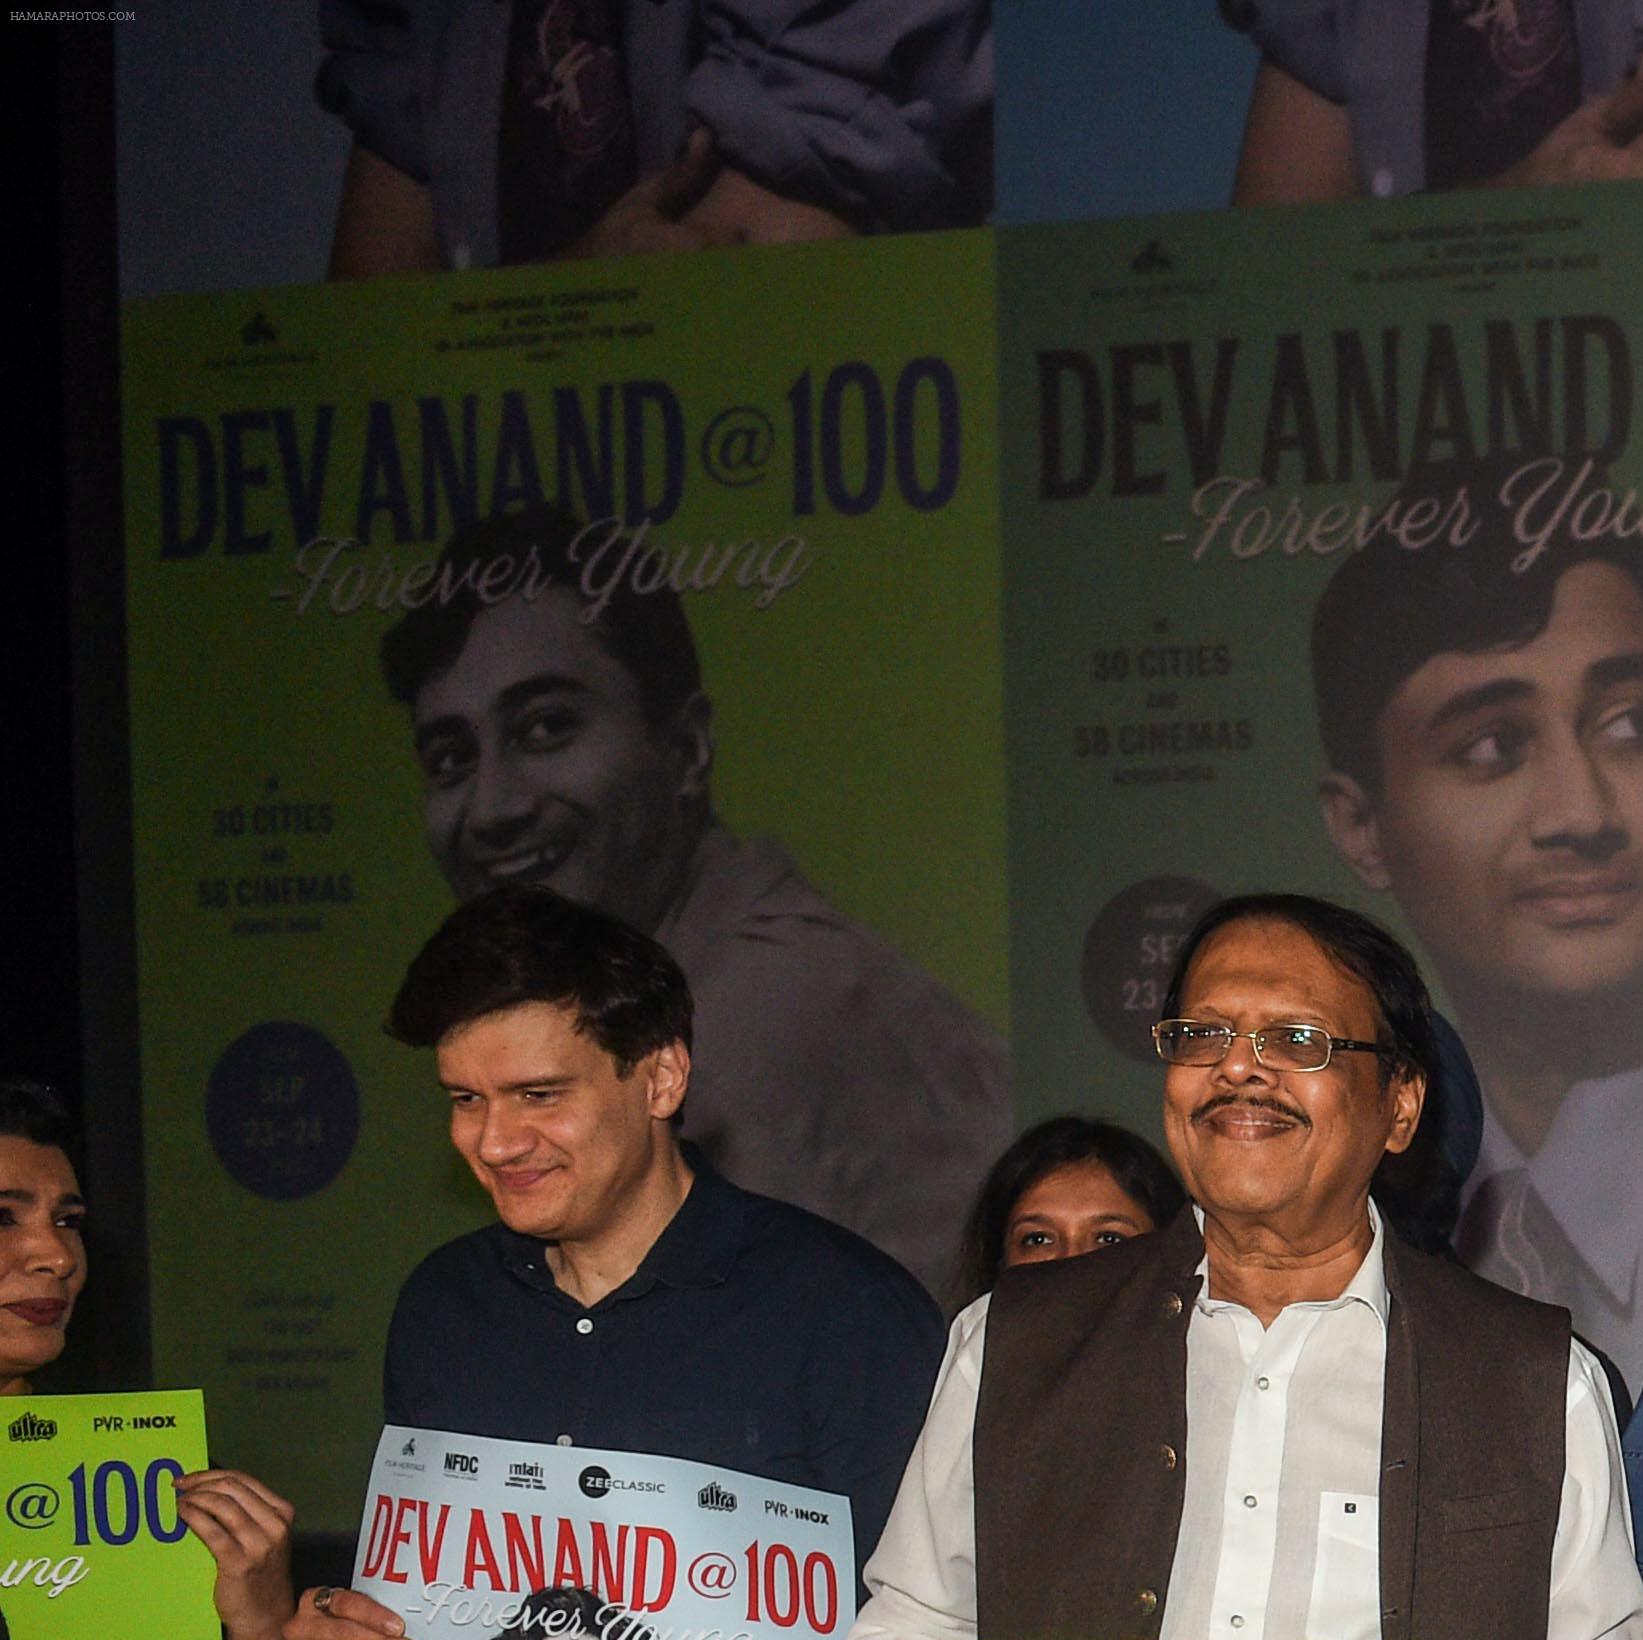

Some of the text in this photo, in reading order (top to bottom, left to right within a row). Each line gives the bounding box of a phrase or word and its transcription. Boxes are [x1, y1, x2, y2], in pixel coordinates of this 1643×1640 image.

[155, 356, 962, 560] DEV ANAND @ 100
[1037, 338, 1238, 502] DEV
[1260, 314, 1632, 486] ANAND
[567, 516, 814, 626] Young
[6, 1458, 188, 1546] @ 100
[362, 1494, 837, 1634] DEV ANAND @ 100
